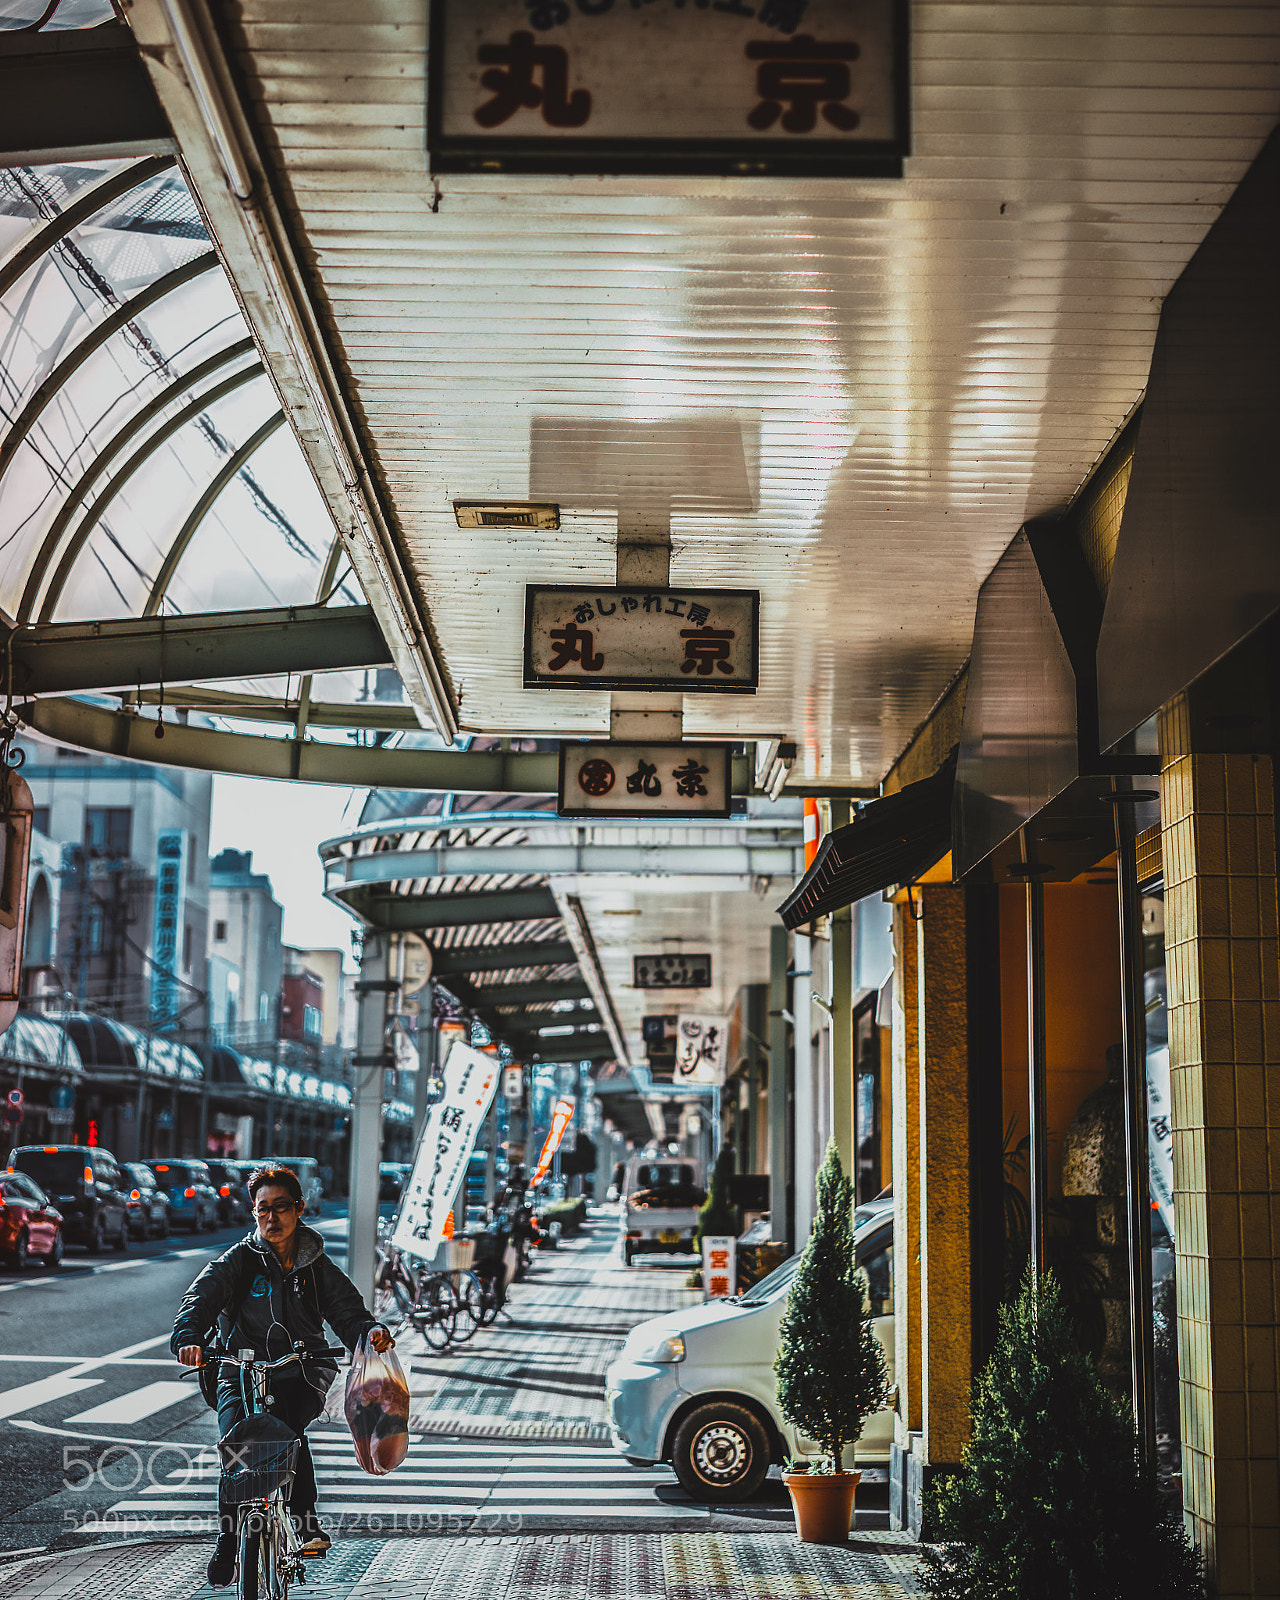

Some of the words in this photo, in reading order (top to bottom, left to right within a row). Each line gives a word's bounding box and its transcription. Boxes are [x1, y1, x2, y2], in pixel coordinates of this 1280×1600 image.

[573, 594, 711, 626] おしゃれ工房
